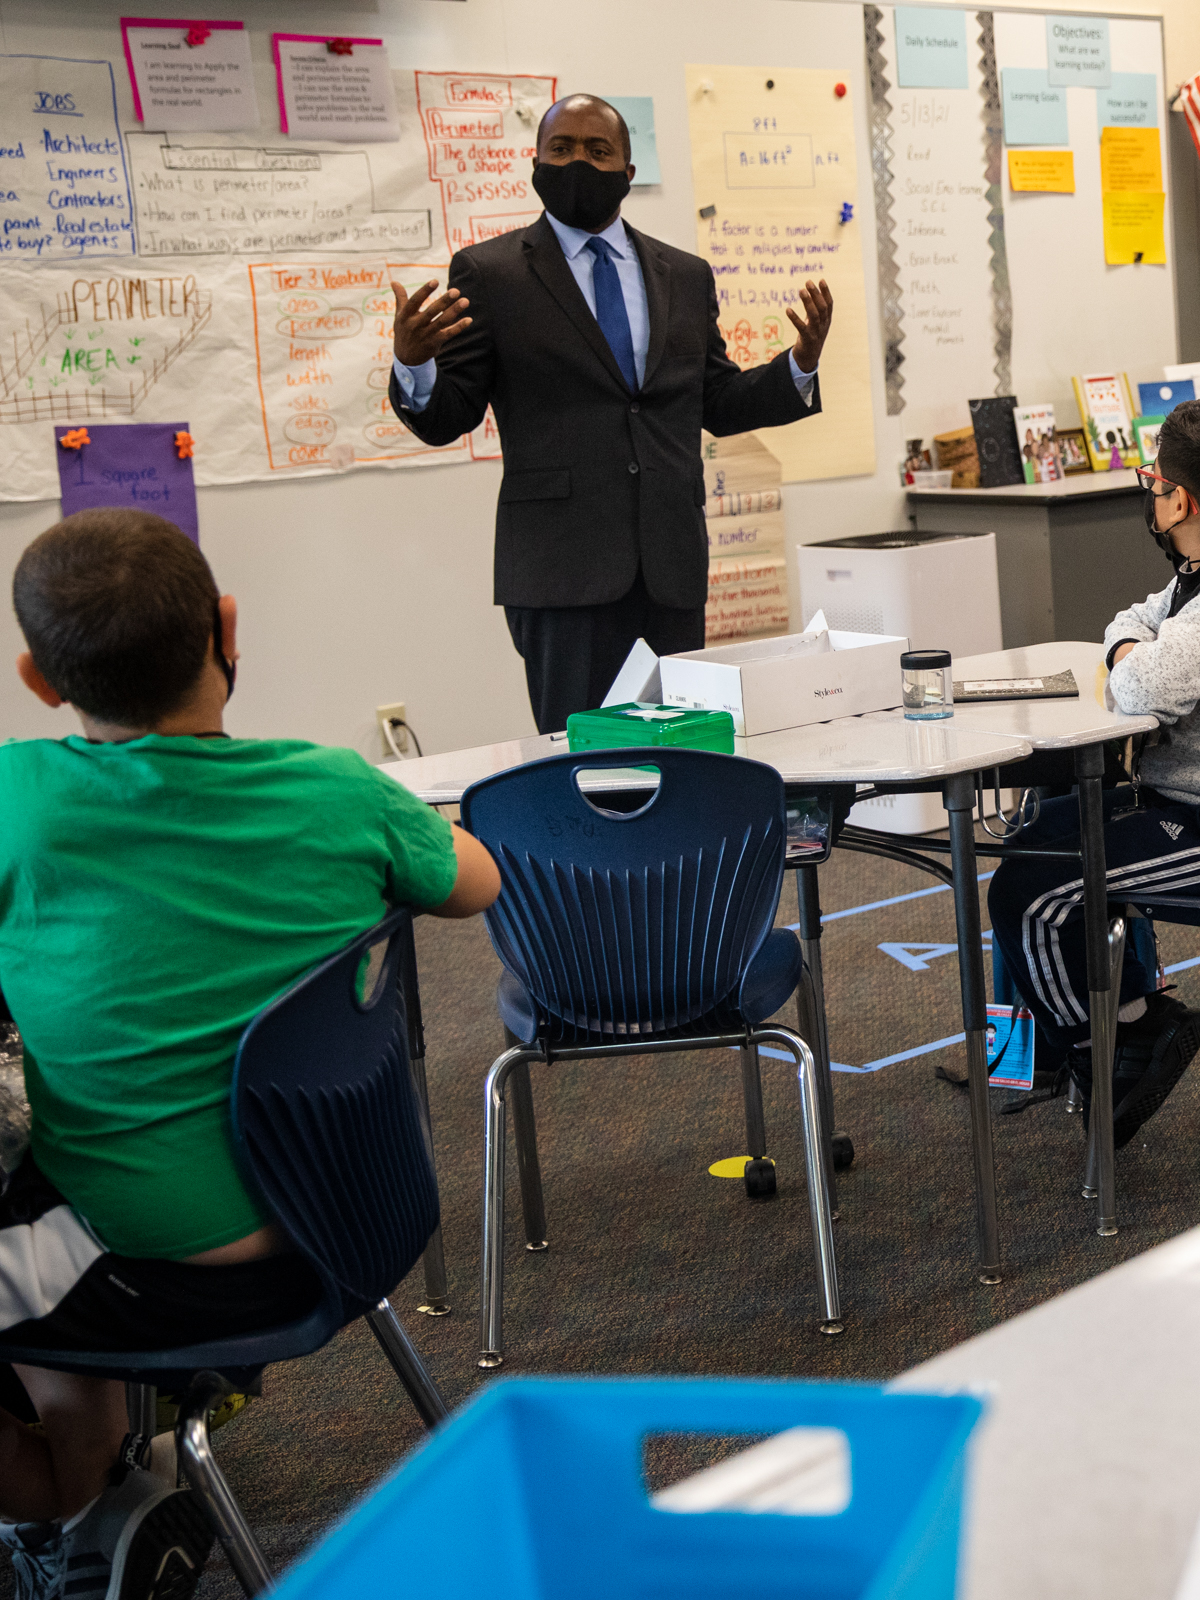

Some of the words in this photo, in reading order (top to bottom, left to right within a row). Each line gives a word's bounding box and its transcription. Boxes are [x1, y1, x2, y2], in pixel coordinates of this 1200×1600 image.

[905, 34, 924, 49] Daily
[925, 36, 958, 49] Schedule
[1053, 23, 1104, 40] Objectives:
[1057, 44, 1077, 54] What
[1078, 46, 1088, 55] are
[1090, 47, 1100, 55] we
[1055, 59, 1081, 71] learning
[1082, 60, 1105, 71] today?
[34, 91, 77, 111] JOBS
[450, 82, 503, 104] Formulas
[1011, 91, 1039, 103] Learning
[1041, 91, 1060, 103] Goals
[1107, 99, 1121, 109] How
[1123, 100, 1135, 109] can
[431, 111, 501, 138] Perimeter
[43, 128, 119, 155] Architects
[467, 143, 518, 160] distance
[166, 150, 238, 168] Essential
[474, 159, 515, 176] shape
[46, 160, 118, 189] Engineers
[141, 171, 182, 192] What
[47, 189, 125, 210] Contractors
[4, 216, 42, 235] paint
[722, 220, 751, 237] factor
[785, 223, 818, 238] number
[17, 234, 53, 255] buy?
[62, 235, 118, 255] agents
[274, 270, 302, 288] Tier
[308, 268, 318, 288] 3
[322, 269, 384, 289] Vocabulary
[790, 262, 824, 277] product
[72, 274, 197, 322] PERIMETER
[61, 347, 121, 375] AREA
[295, 416, 331, 437] edge
[101, 466, 158, 488] square
[131, 484, 170, 501] foot
[718, 527, 760, 546] number
[1159, 820, 1178, 841] adidas
